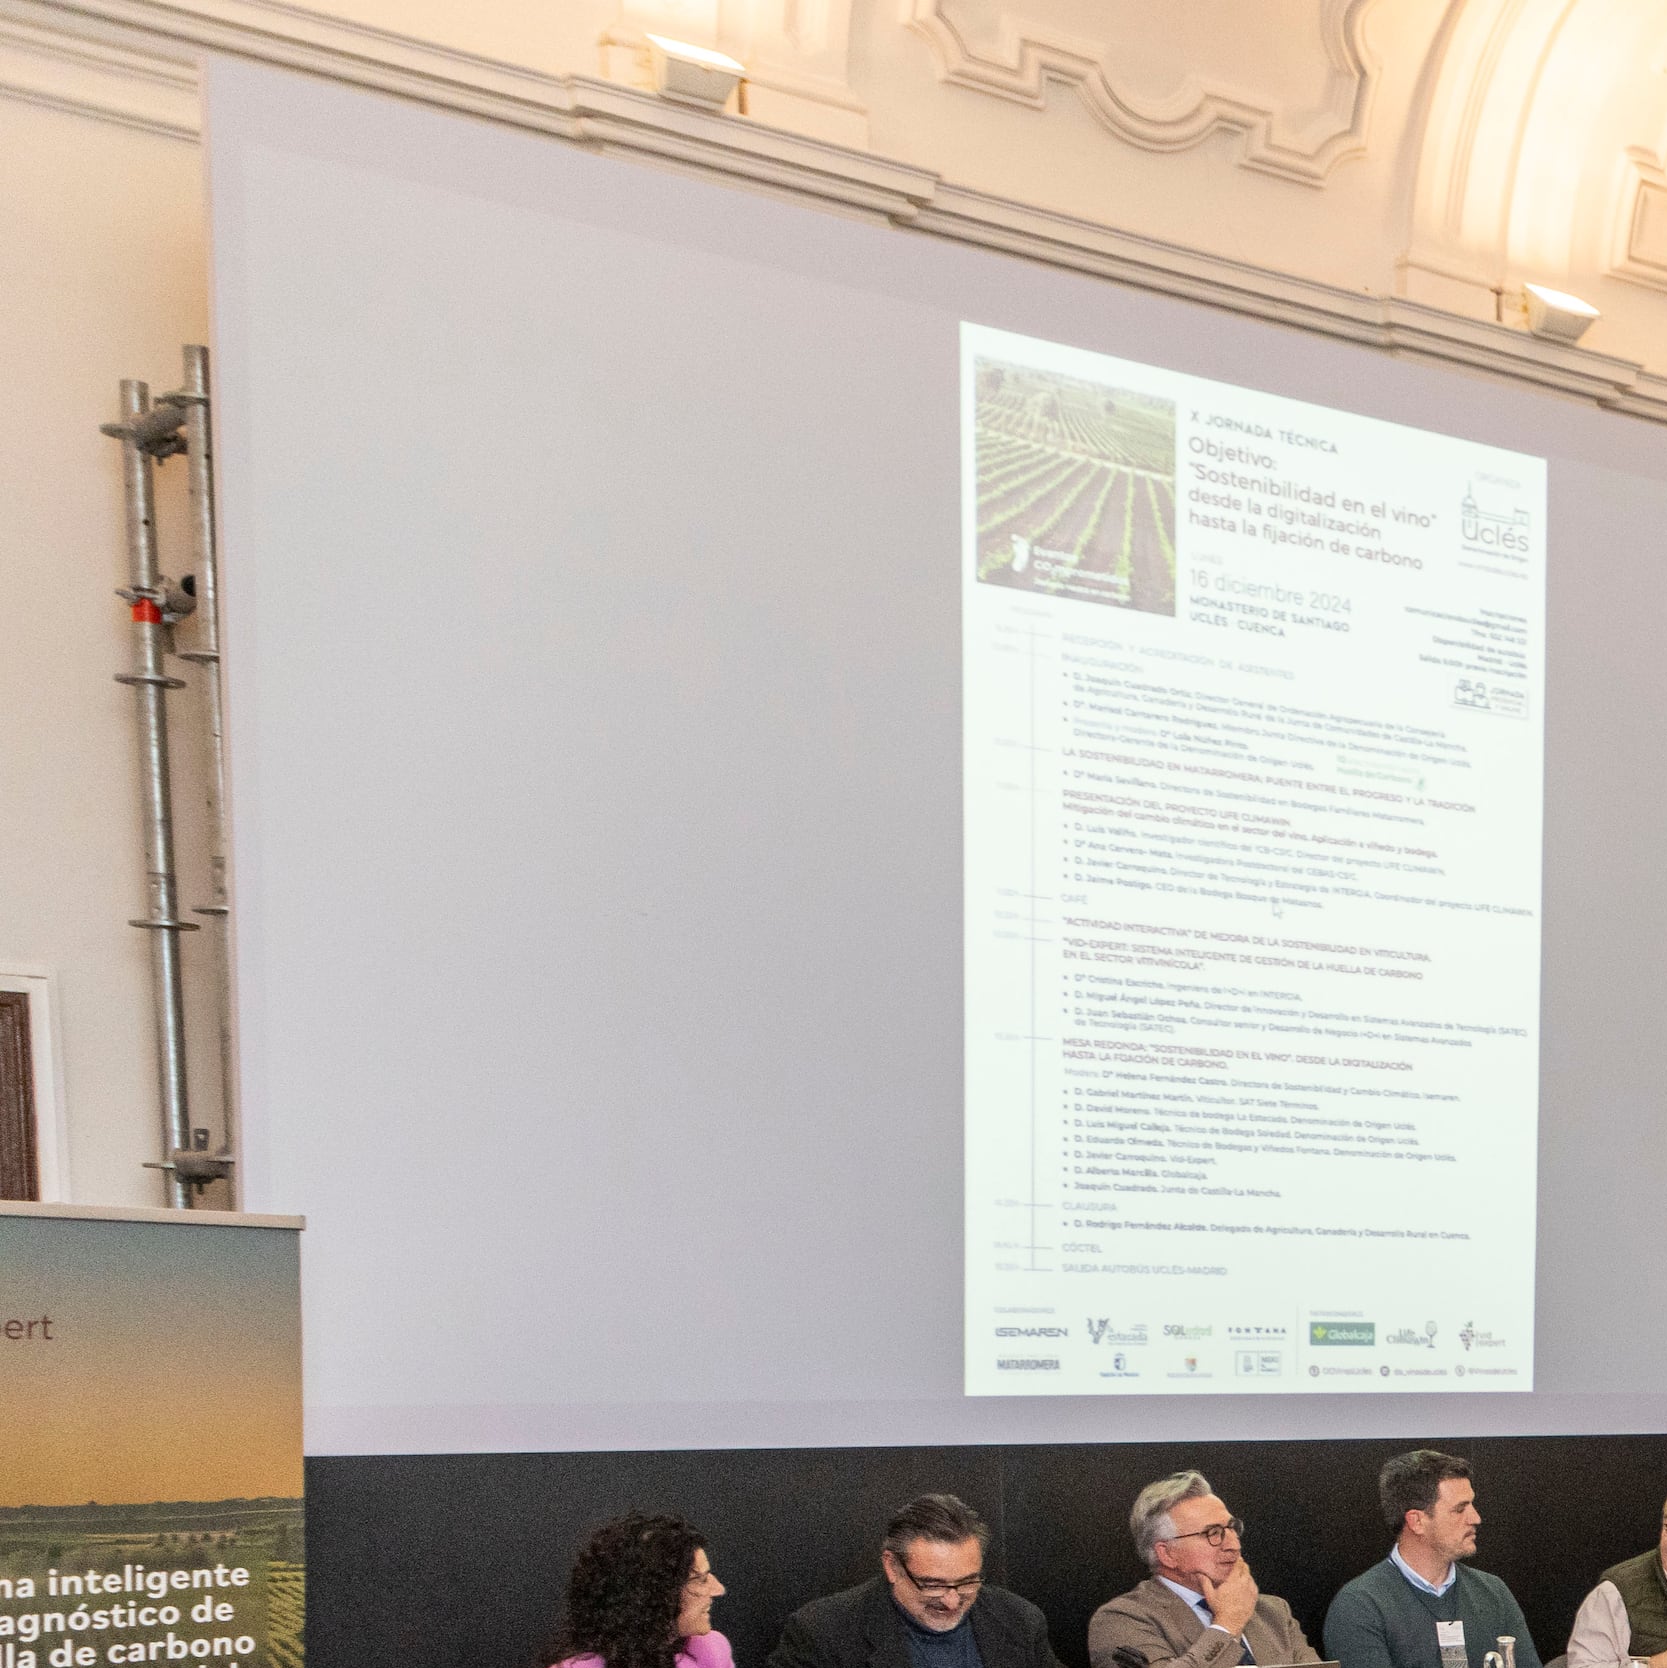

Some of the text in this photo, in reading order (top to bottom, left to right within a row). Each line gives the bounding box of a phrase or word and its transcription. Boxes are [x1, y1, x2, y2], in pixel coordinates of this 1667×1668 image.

[1190, 411, 1338, 454] X JORNADA TÉCNICA
[1189, 436, 1278, 470] Objetivo:
[1189, 488, 1381, 540] desde la digitalización
[1342, 498, 1364, 514] en
[1371, 502, 1386, 518] el
[1189, 509, 1423, 570] hasta la fijación de carbono
[1462, 519, 1529, 552] Uclés
[1190, 568, 1352, 613] 16 diciembre 2024
[1189, 595, 1350, 632] MONASTERIO DE SANTIAGO
[1237, 617, 1286, 637] CUENCA
[48, 1564, 250, 1599] inteligente
[191, 1595, 235, 1624] de
[50, 1639, 97, 1668] de
[107, 1632, 256, 1664] carbono
